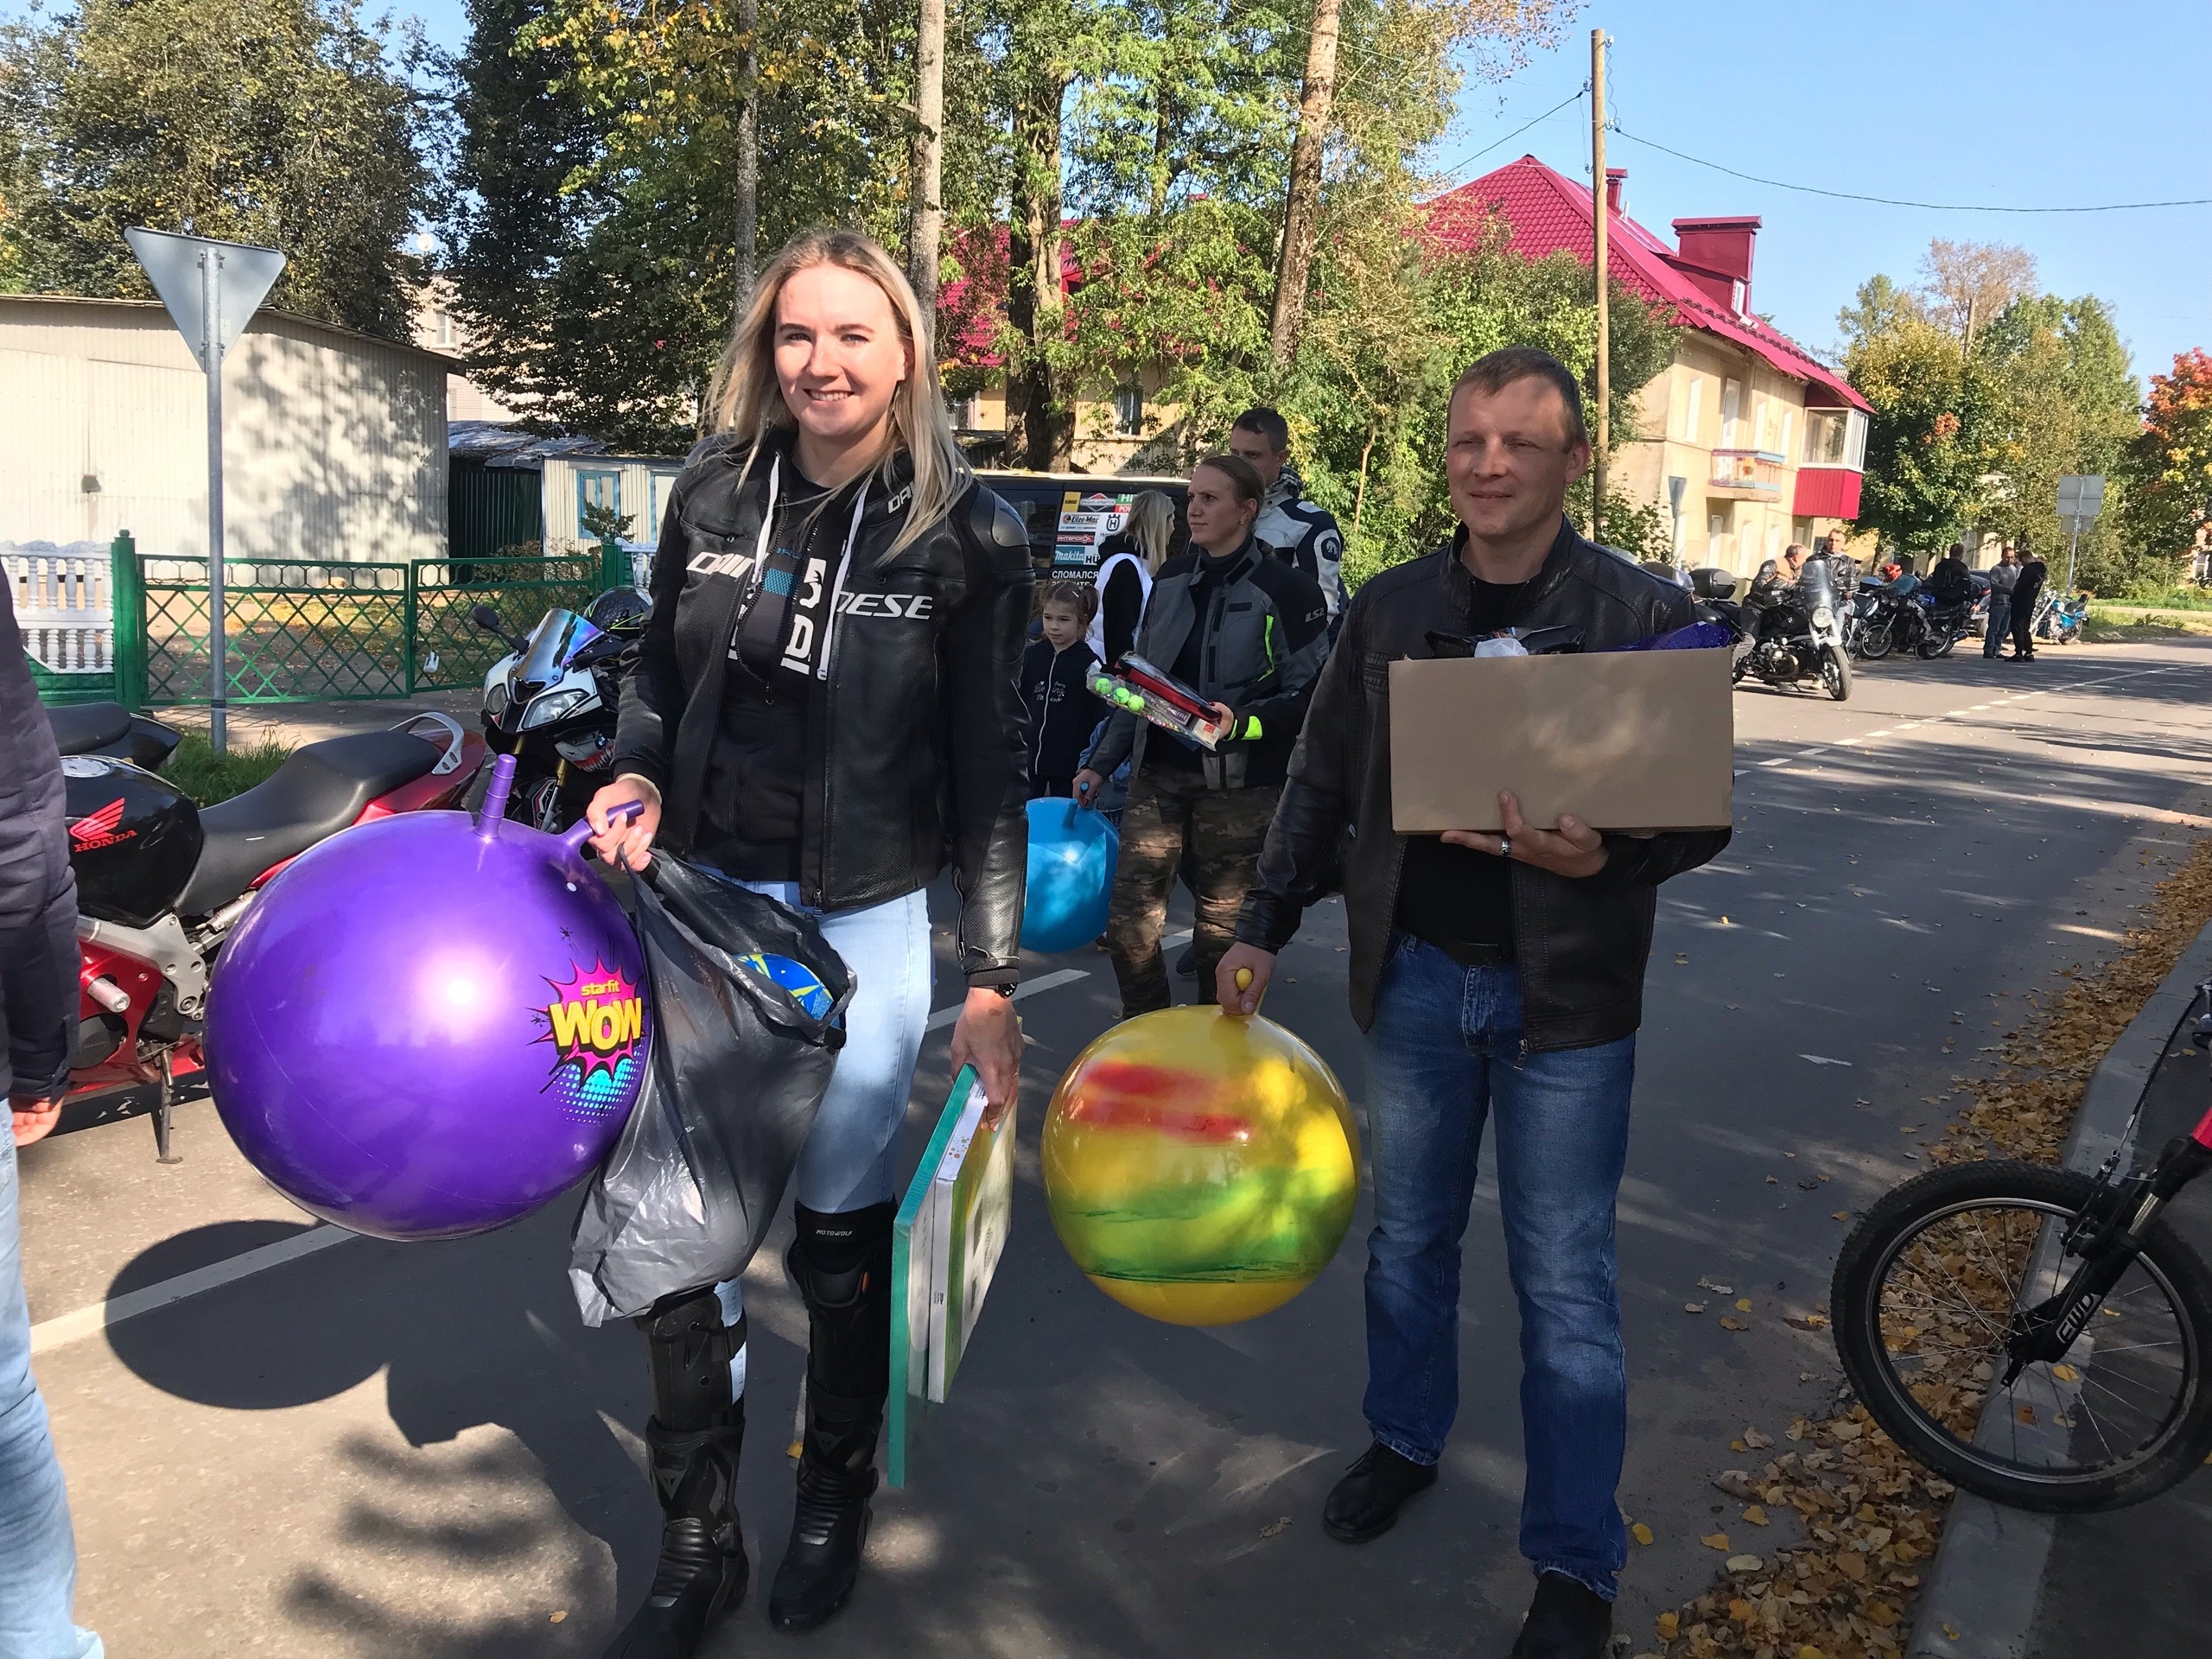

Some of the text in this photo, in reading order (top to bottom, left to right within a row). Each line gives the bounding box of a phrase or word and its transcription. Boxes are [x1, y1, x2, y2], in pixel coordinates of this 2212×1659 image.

[1052, 570, 1098, 579] СЛОМАЛСЯ
[1305, 607, 1325, 622] LS2
[73, 830, 137, 853] HONDA
[582, 979, 620, 996] starfit
[549, 997, 642, 1051] WOW
